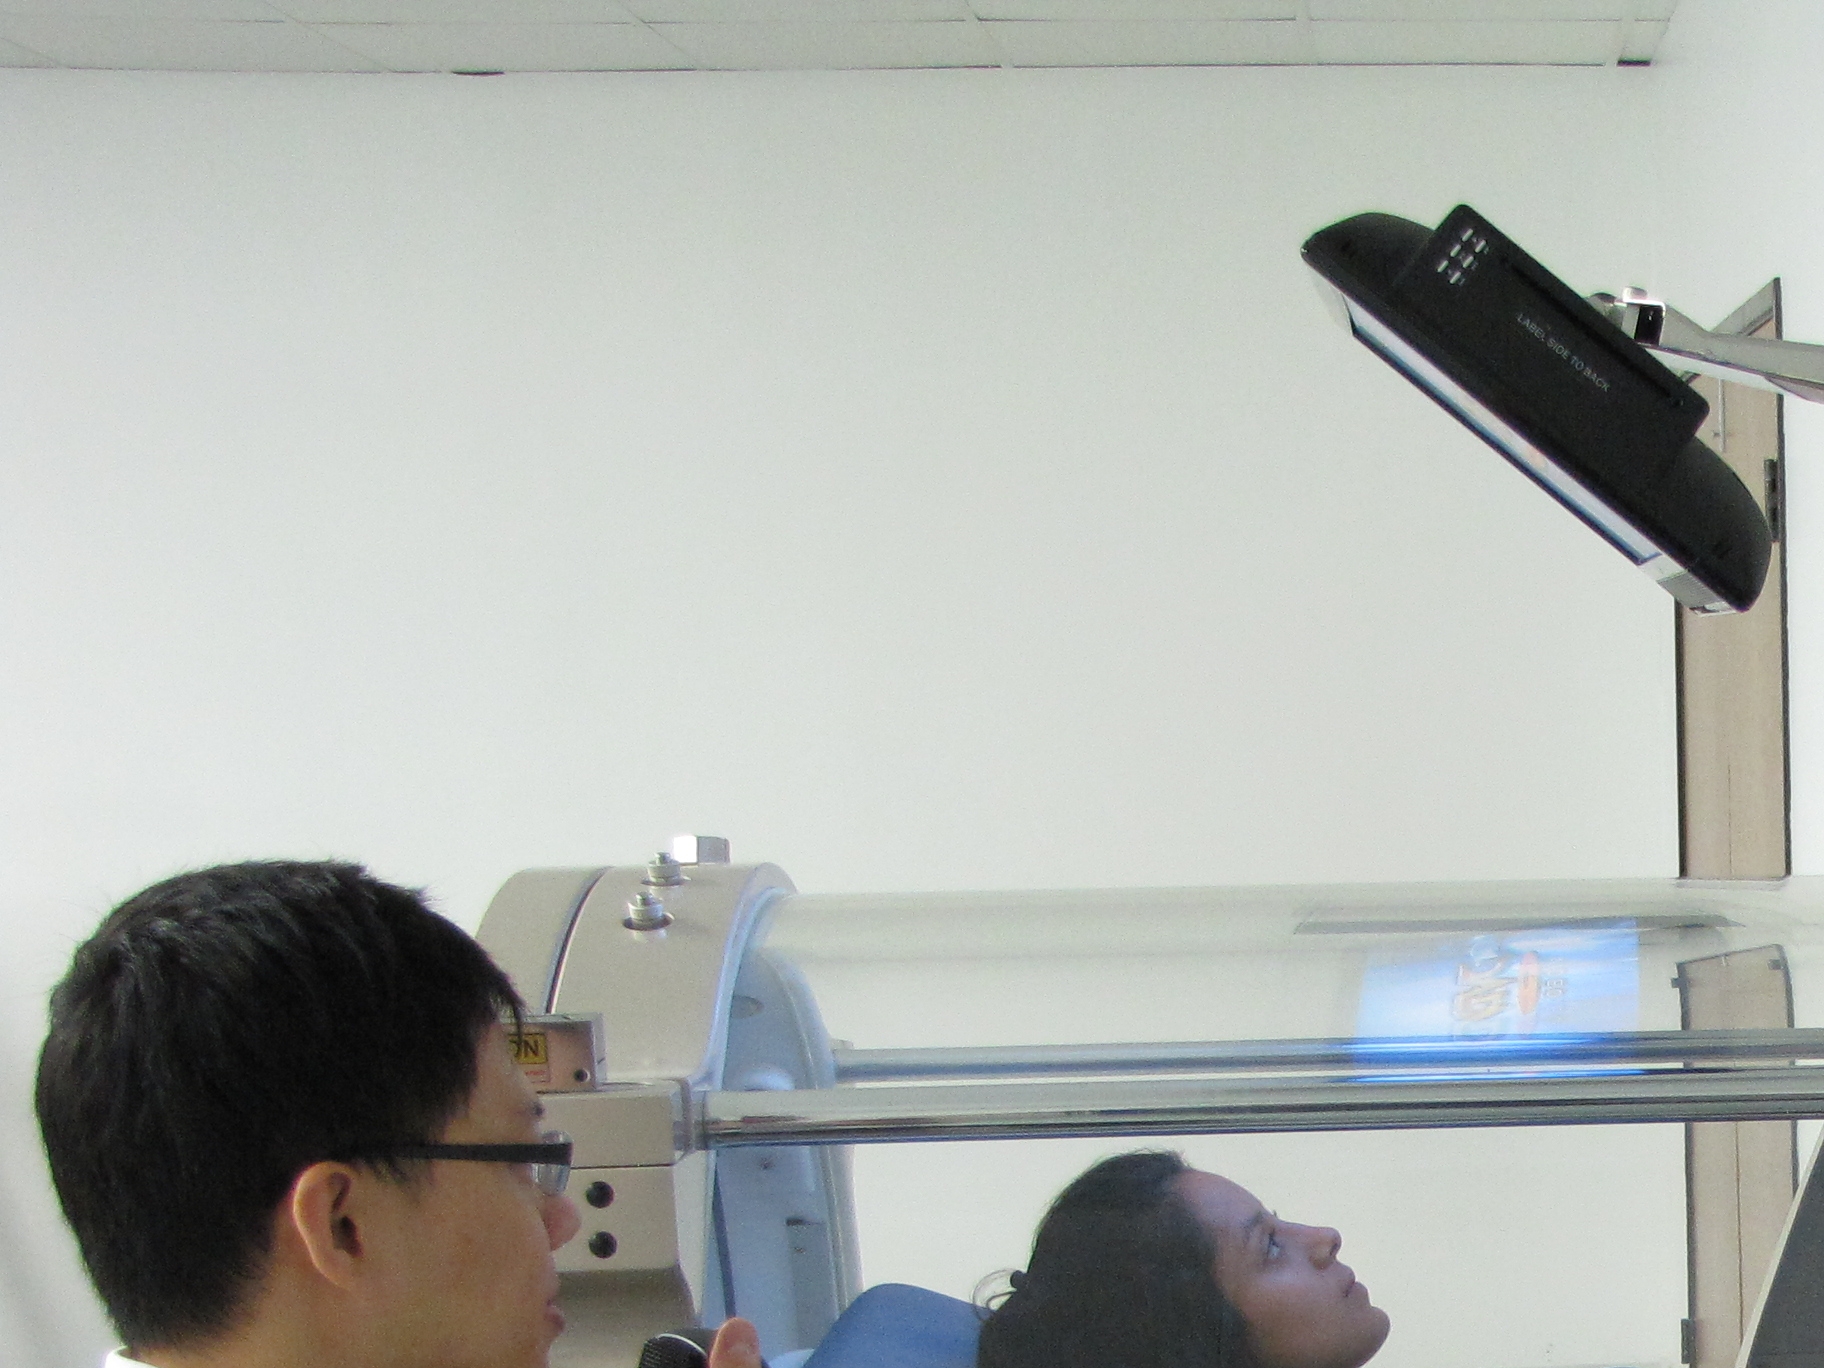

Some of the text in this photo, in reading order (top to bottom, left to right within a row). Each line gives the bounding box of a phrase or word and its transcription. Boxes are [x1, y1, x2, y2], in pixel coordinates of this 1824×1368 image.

[1516, 312, 1610, 392] LABEL SIDE TO BACK
